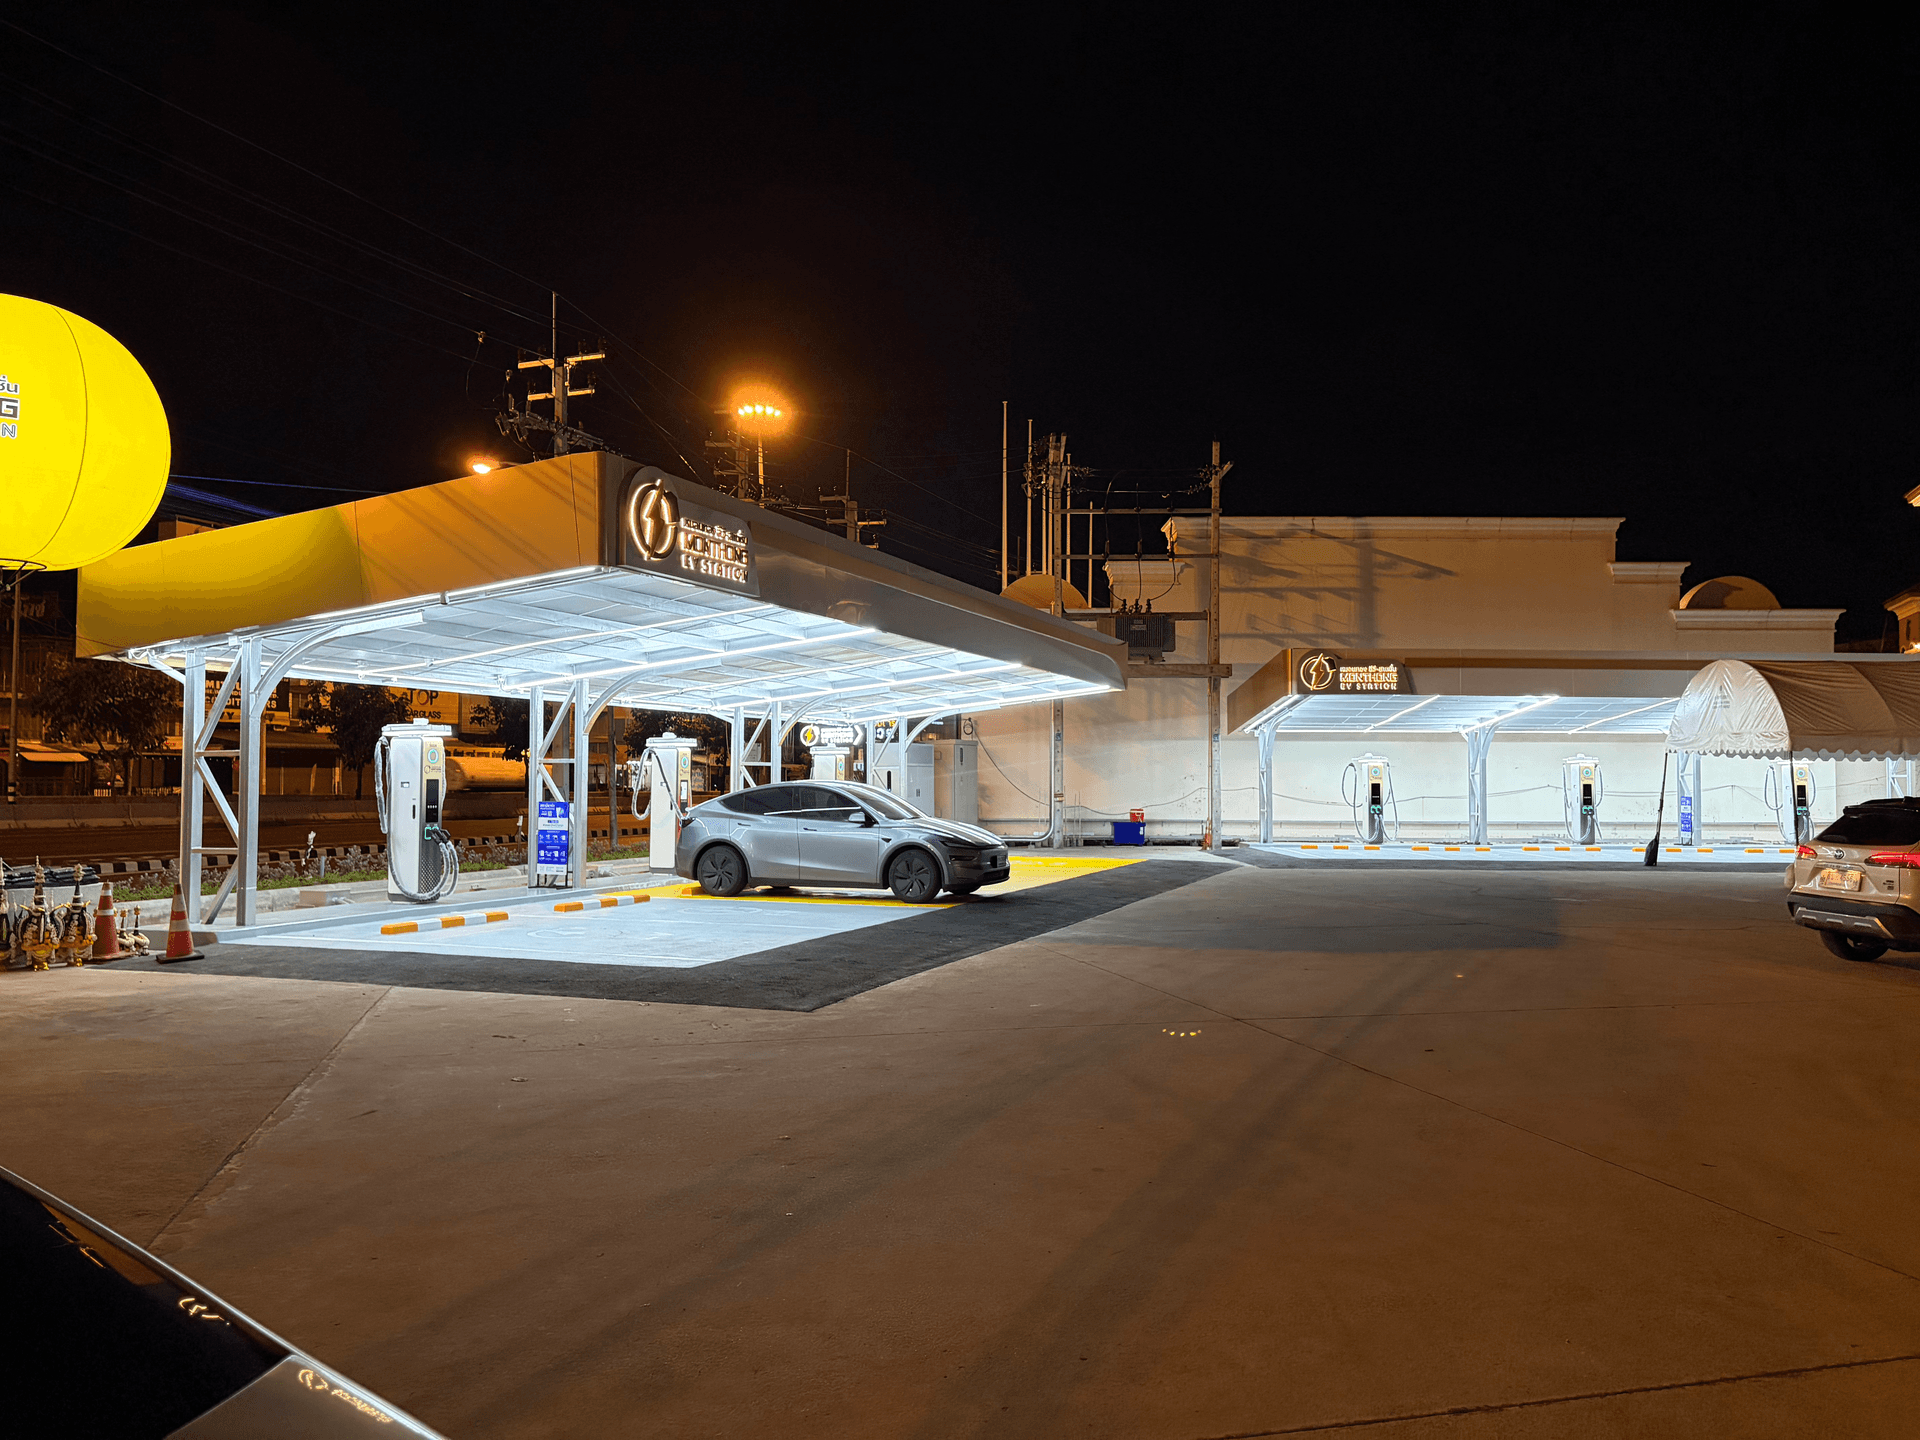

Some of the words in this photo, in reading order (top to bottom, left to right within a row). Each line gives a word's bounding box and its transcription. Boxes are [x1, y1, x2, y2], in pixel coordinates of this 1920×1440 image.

[680, 531, 749, 567] MONTHONG
[681, 553, 699, 570] EV
[701, 558, 748, 583] STATION
[1340, 672, 1398, 683] MONTHONG
[407, 688, 439, 705] TOP
